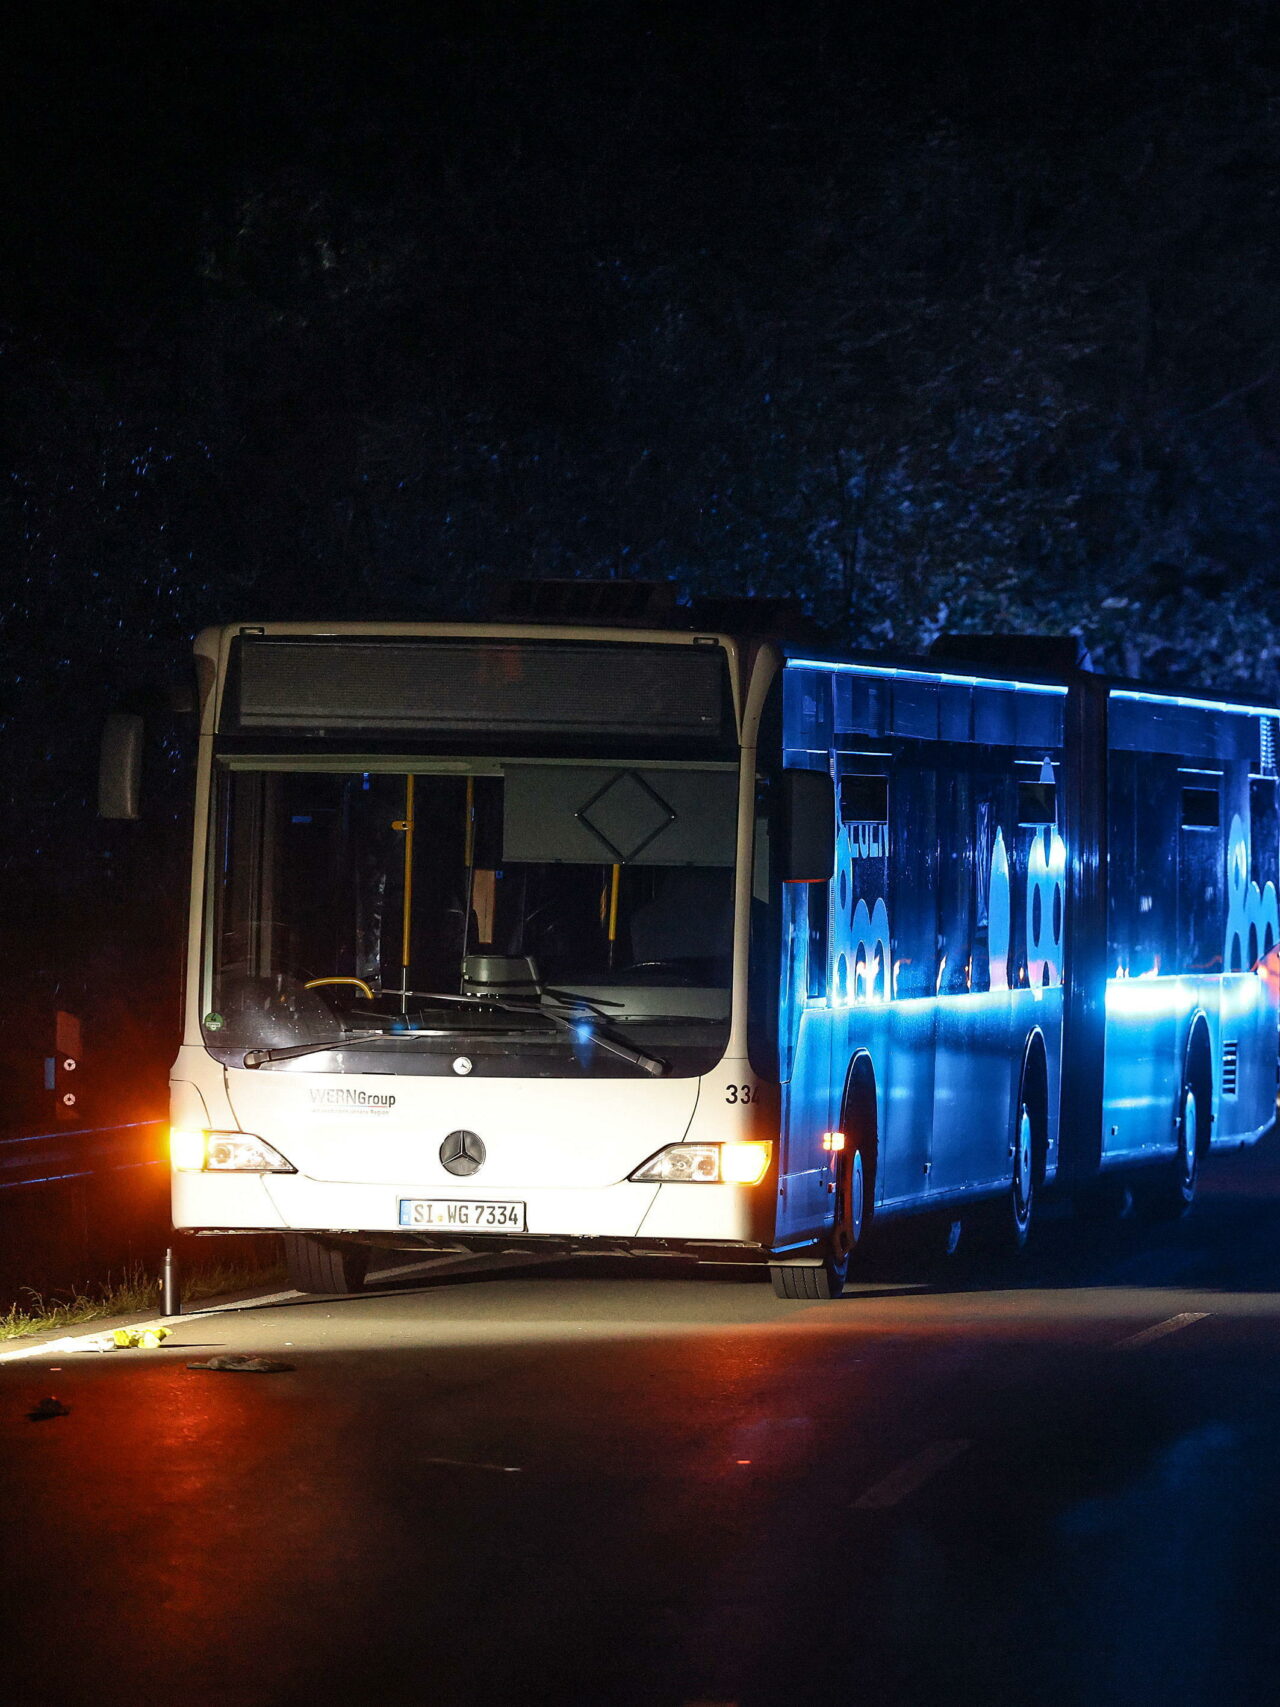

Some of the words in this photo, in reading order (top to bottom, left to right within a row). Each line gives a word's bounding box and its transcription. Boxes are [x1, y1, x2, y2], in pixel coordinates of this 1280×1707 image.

[414, 1204, 433, 1223] SI
[447, 1205, 469, 1224] WG
[474, 1205, 518, 1225] 7334
